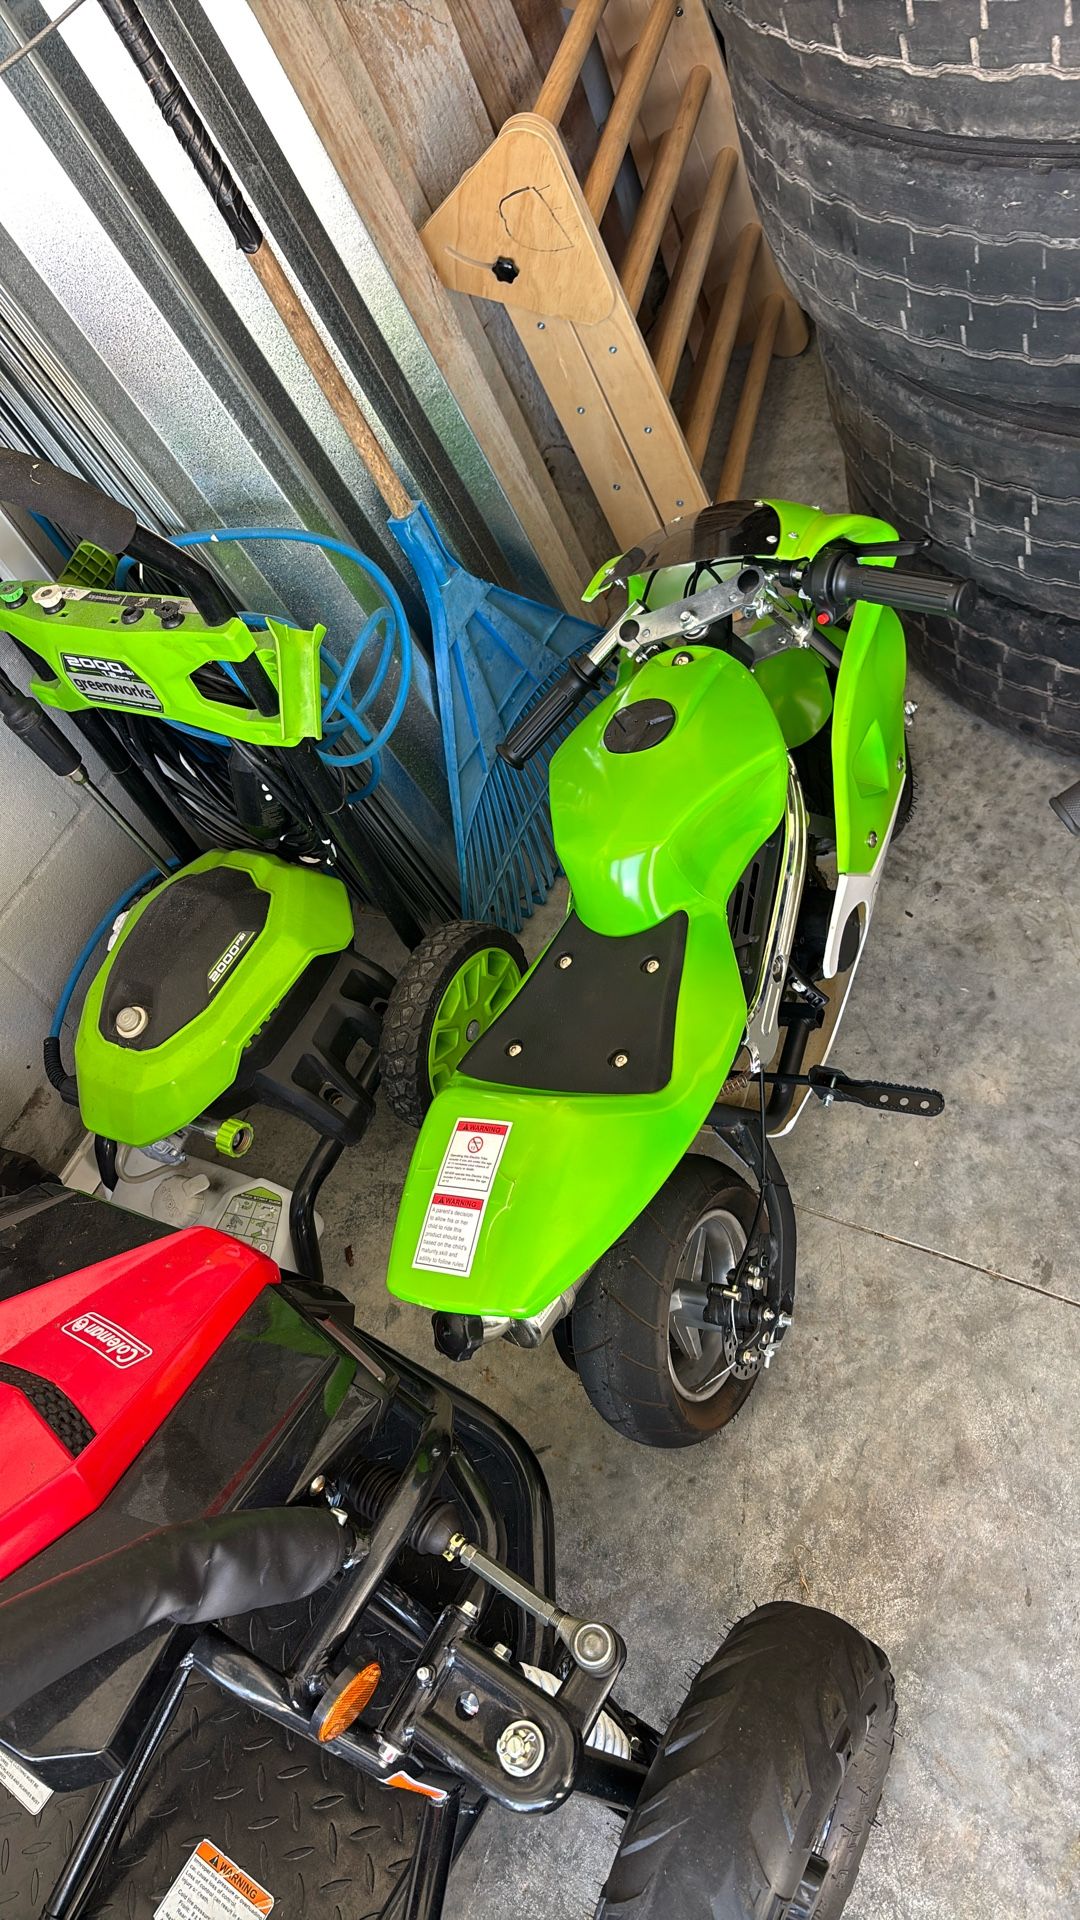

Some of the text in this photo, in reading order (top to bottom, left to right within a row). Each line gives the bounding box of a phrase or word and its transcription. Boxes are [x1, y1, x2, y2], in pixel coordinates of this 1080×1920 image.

[73, 678, 156, 700] greenworks
[470, 1124, 501, 1133] WARNING
[445, 1198, 477, 1208] WARNING
[84, 1324, 138, 1362] Coleman
[220, 1862, 257, 1899] WARNING
